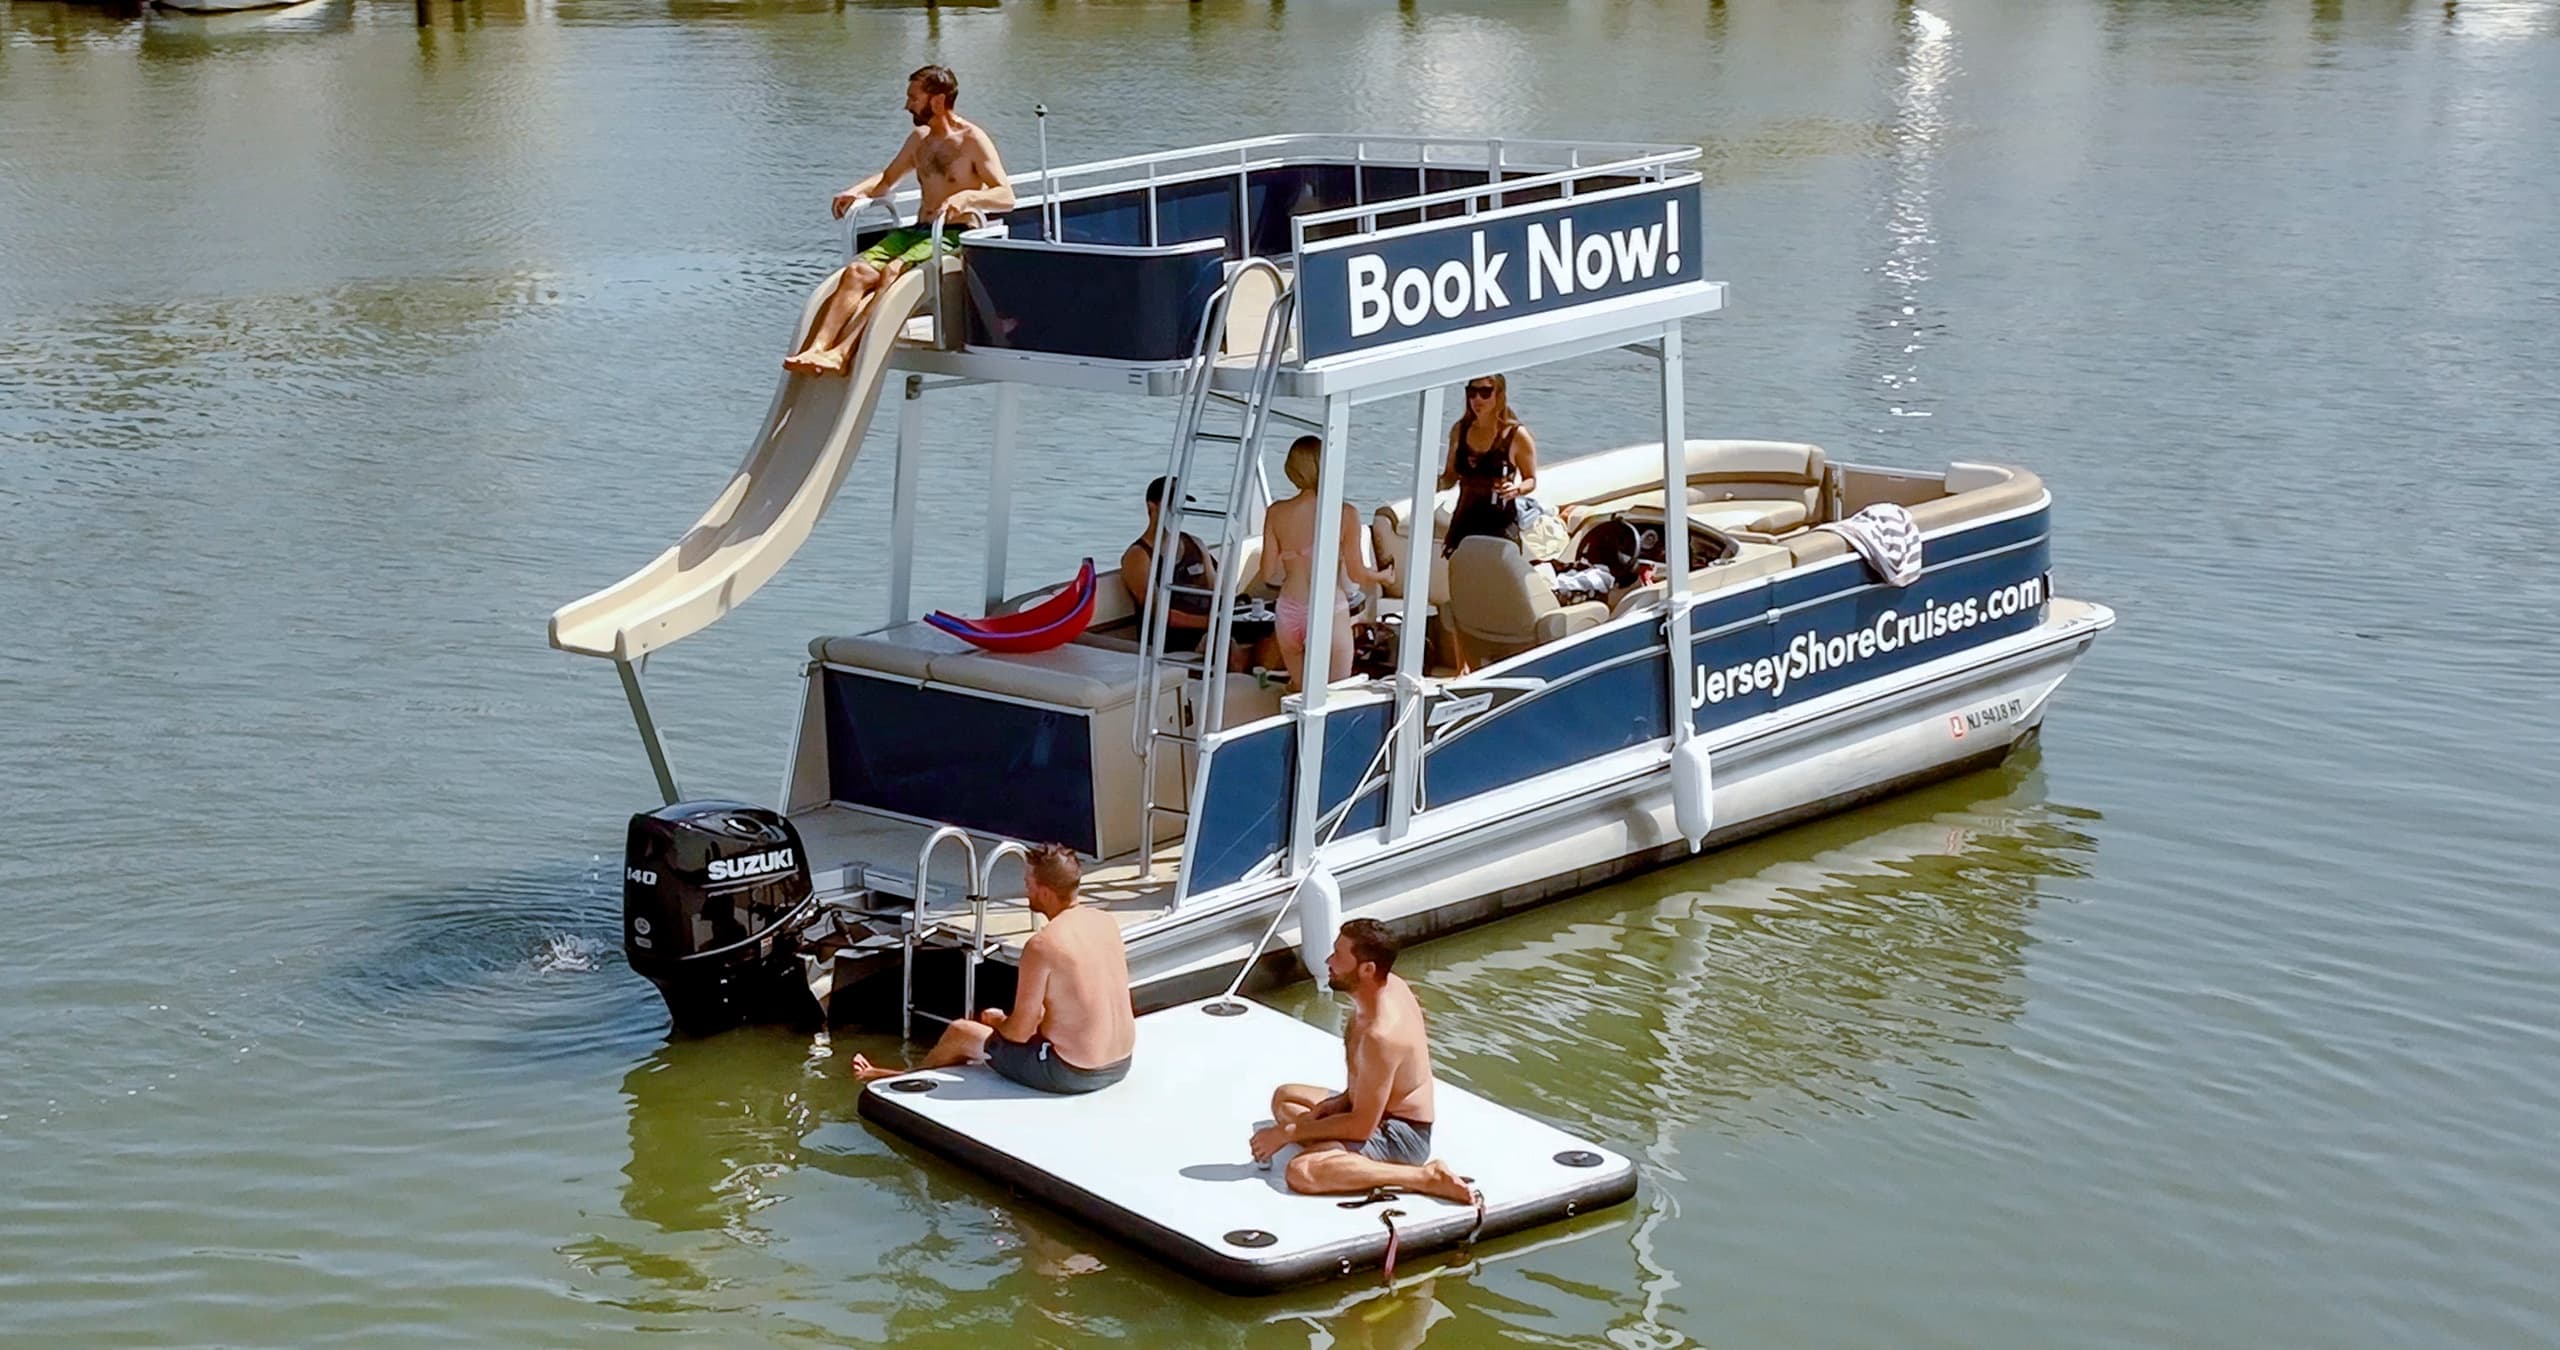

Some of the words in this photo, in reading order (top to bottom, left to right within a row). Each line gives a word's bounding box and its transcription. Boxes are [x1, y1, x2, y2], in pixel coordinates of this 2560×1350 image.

[1346, 230, 1511, 339] Book
[1526, 199, 1682, 301] Now!
[1691, 577, 2041, 709] JerseyShoreCruises.com
[1966, 711, 1981, 730] NJ
[1981, 703, 2009, 726] 9418
[2008, 699, 2023, 716] HT
[626, 866, 658, 886] 140
[707, 848, 794, 881] SUZUKI
